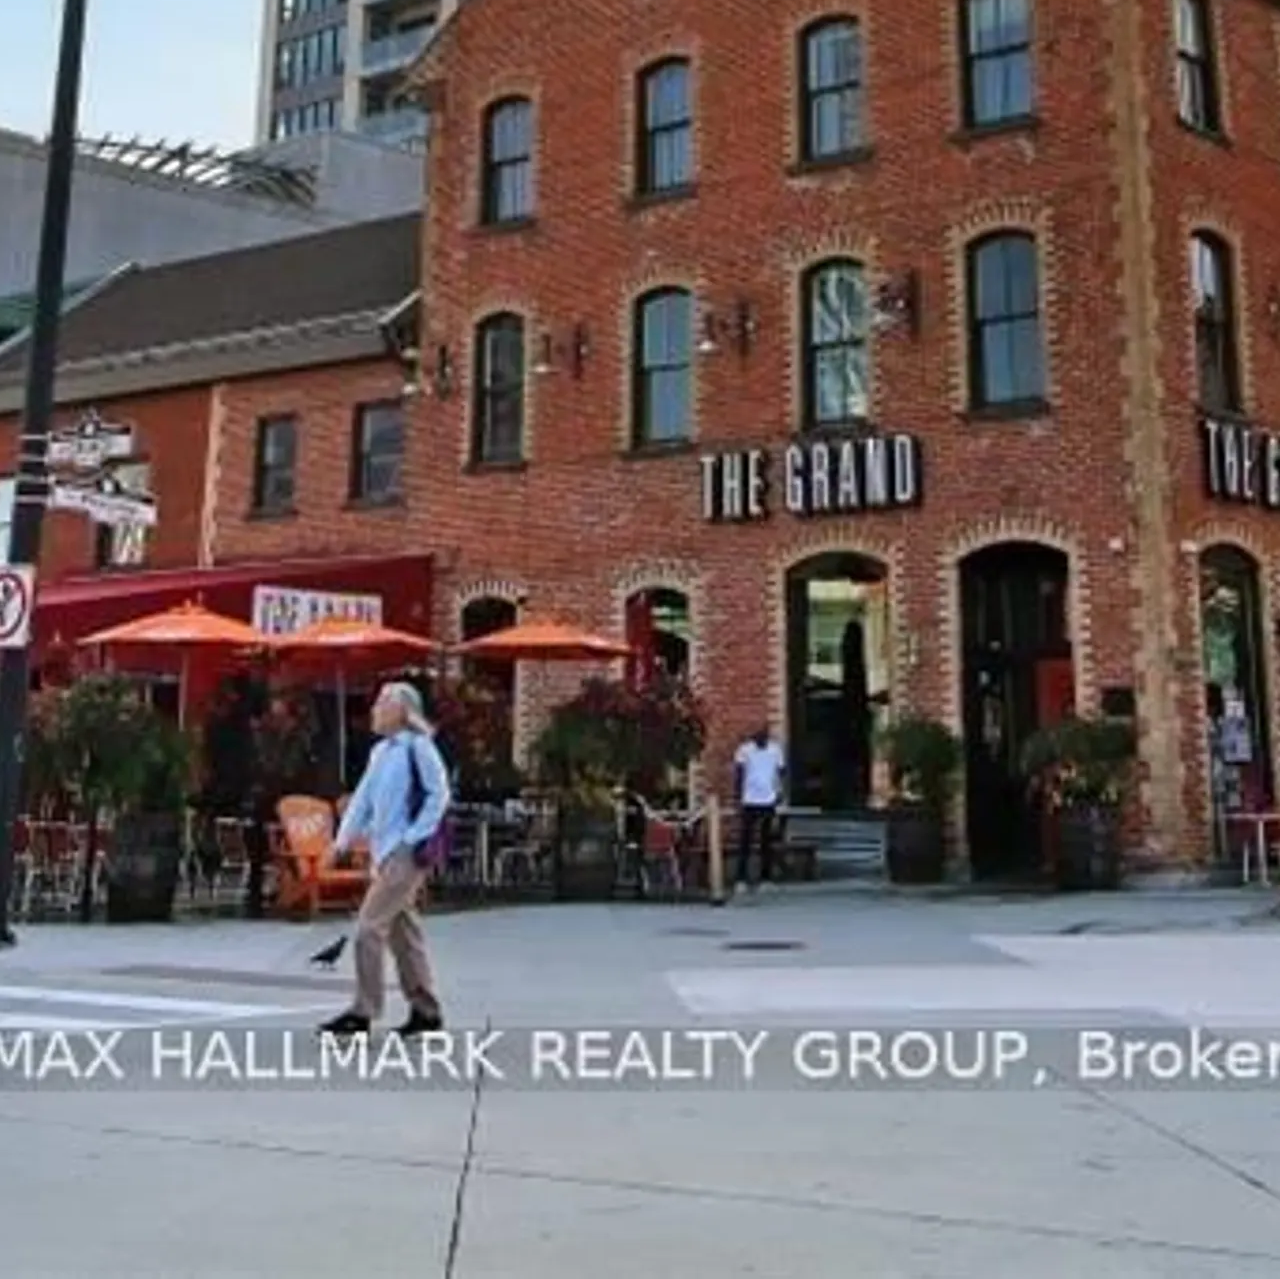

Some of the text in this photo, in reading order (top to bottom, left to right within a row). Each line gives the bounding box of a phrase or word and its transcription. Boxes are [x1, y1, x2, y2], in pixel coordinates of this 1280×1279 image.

[700, 434, 914, 518] THE GRAND
[1205, 419, 1254, 500] THE
